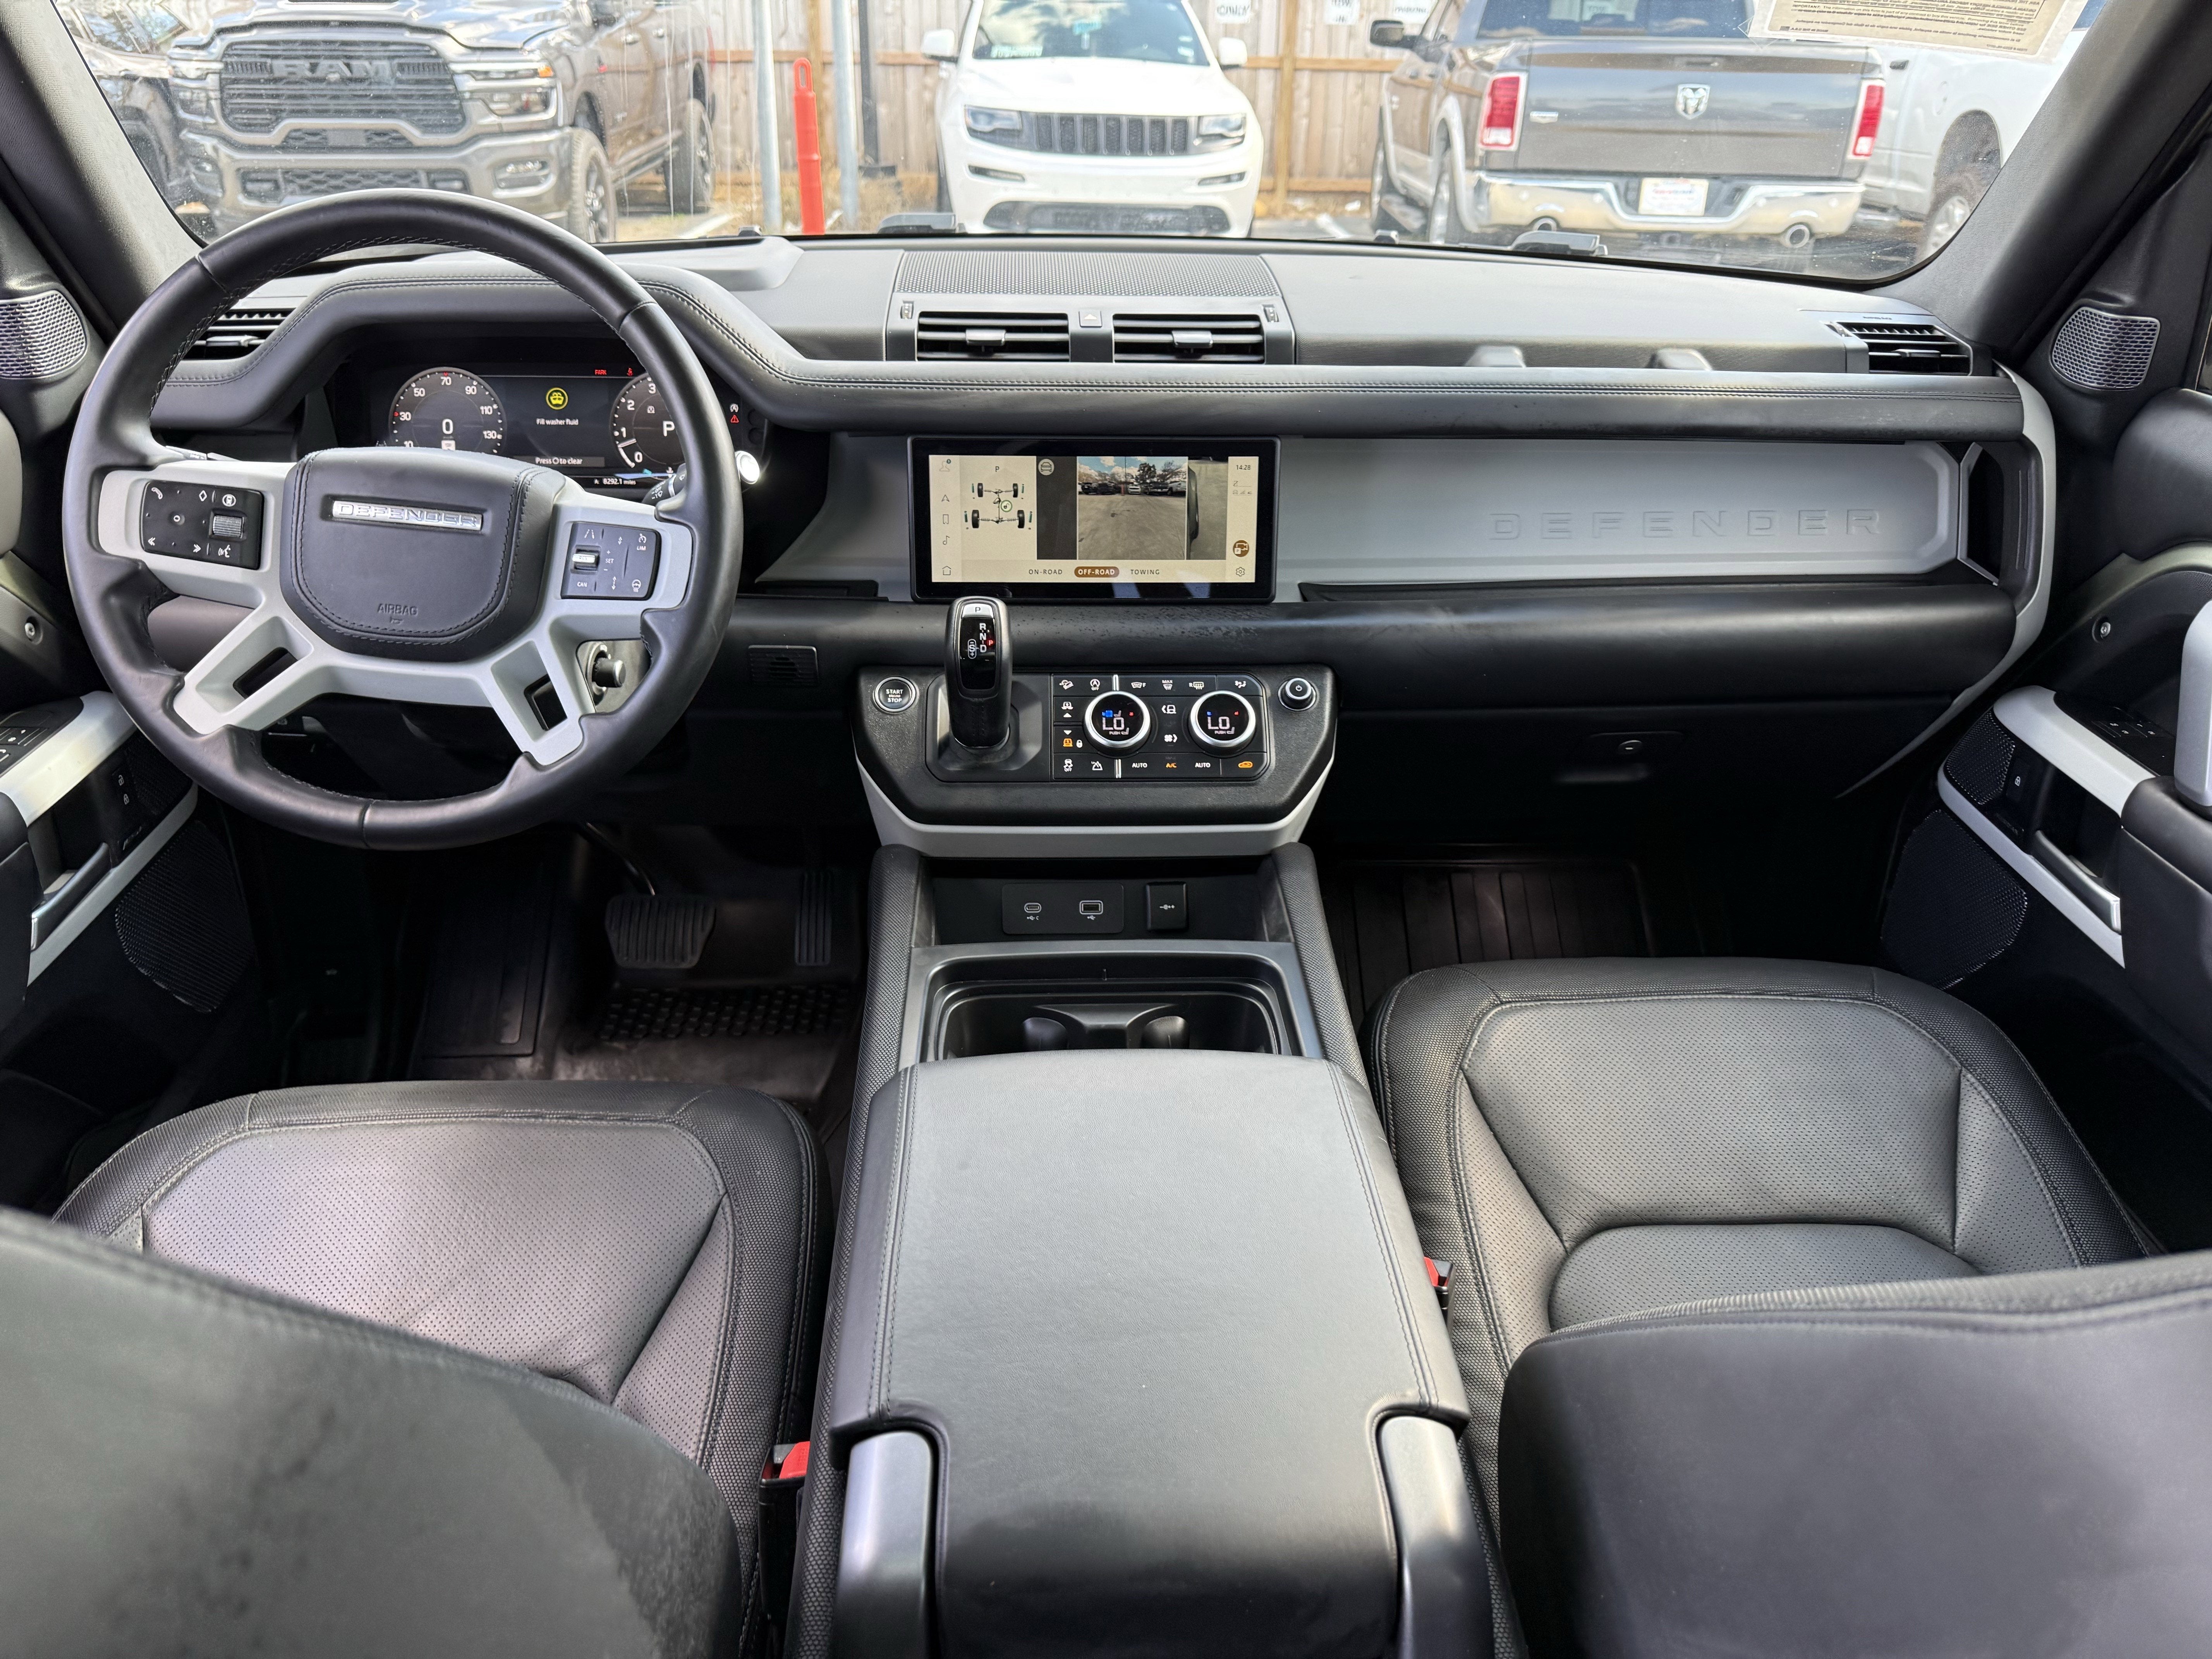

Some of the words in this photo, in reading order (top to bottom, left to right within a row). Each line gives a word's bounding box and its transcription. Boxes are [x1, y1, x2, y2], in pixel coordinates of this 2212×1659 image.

[272, 59, 393, 78] RAM
[440, 376, 452, 385] 70
[414, 388, 425, 397] 50
[465, 386, 477, 395] 90
[648, 383, 656, 394] 3
[480, 406, 493, 415] 110
[627, 400, 635, 410] 2
[400, 412, 411, 421] 30
[442, 419, 453, 434] 0
[663, 421, 675, 437] P
[483, 430, 497, 439] 130
[621, 427, 626, 438] 1
[634, 452, 643, 463] 0
[339, 503, 477, 527] DEFENDER
[1489, 509, 1880, 540] DEFENDER
[377, 603, 418, 616] AIRBAG
[980, 644, 987, 653] D
[1102, 717, 1125, 730] LO
[1207, 716, 1230, 730] LO
